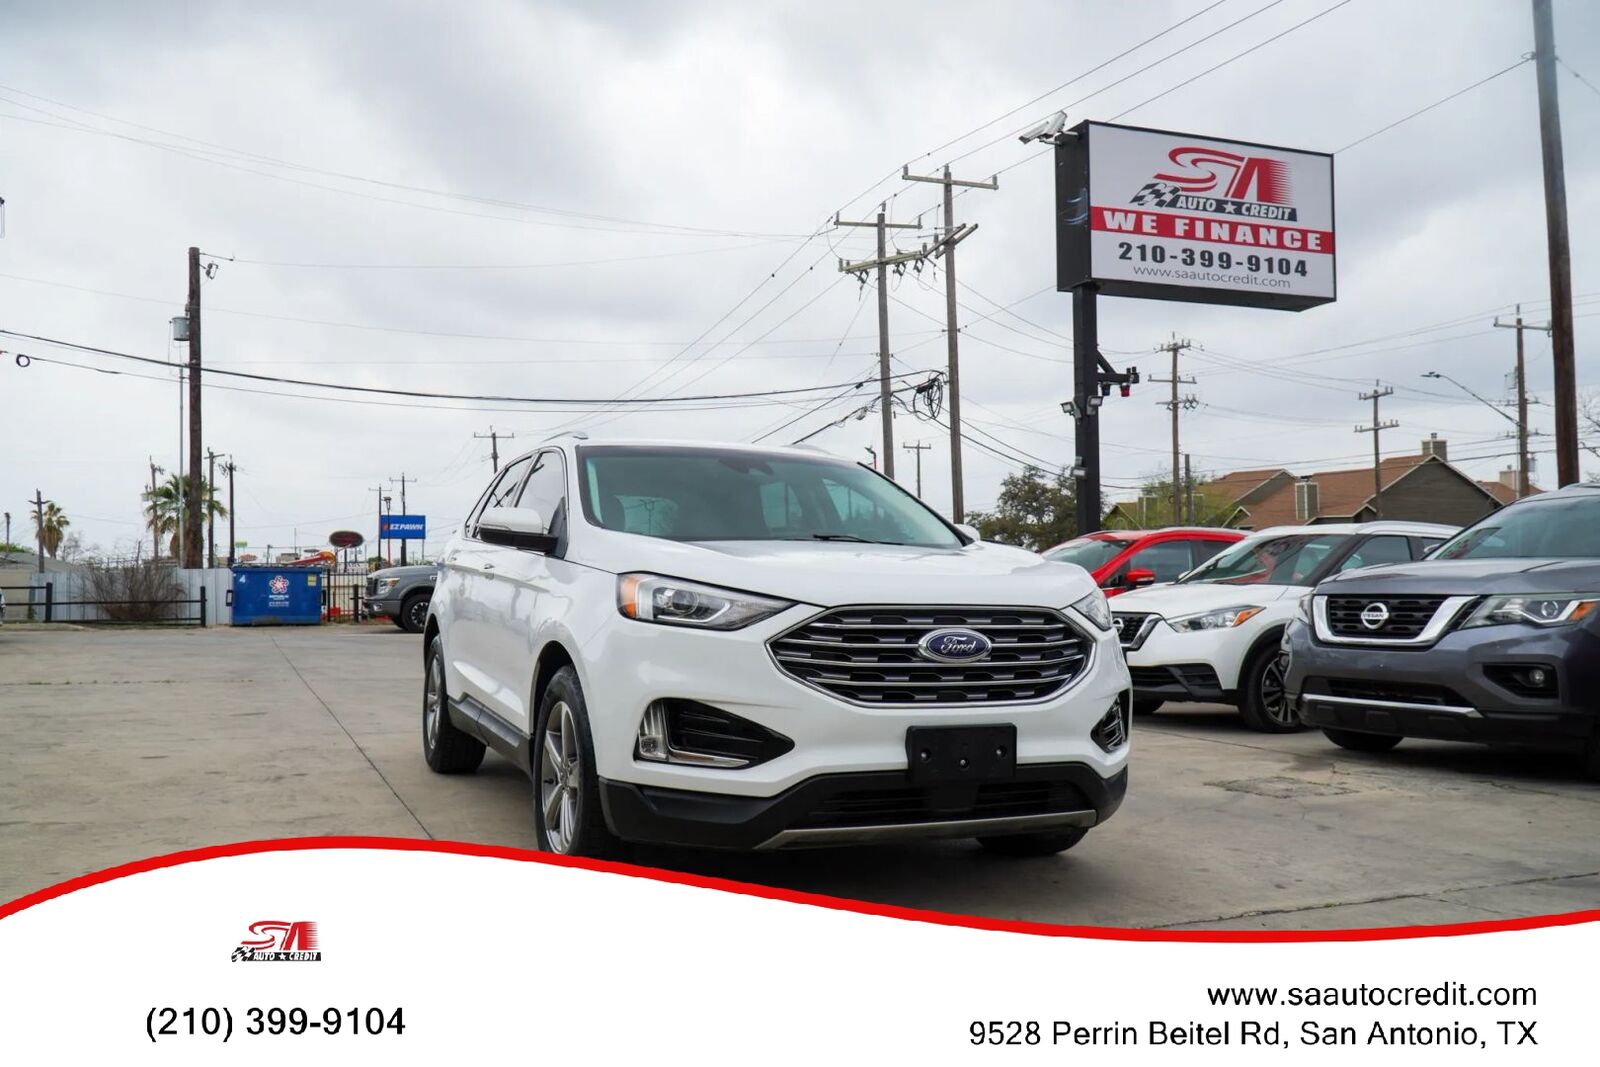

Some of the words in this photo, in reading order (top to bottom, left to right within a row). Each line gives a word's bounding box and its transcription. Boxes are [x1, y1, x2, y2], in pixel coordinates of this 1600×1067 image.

[1152, 146, 1294, 205] SA
[1176, 194, 1217, 212] AUTO
[1241, 205, 1292, 221] CREDIT
[1102, 210, 1158, 234] WE
[1174, 220, 1322, 251] FINANCE
[1118, 241, 1308, 277] 210-399-9104
[1133, 264, 1291, 289] www.saautocredit.com
[940, 636, 977, 653] Ford
